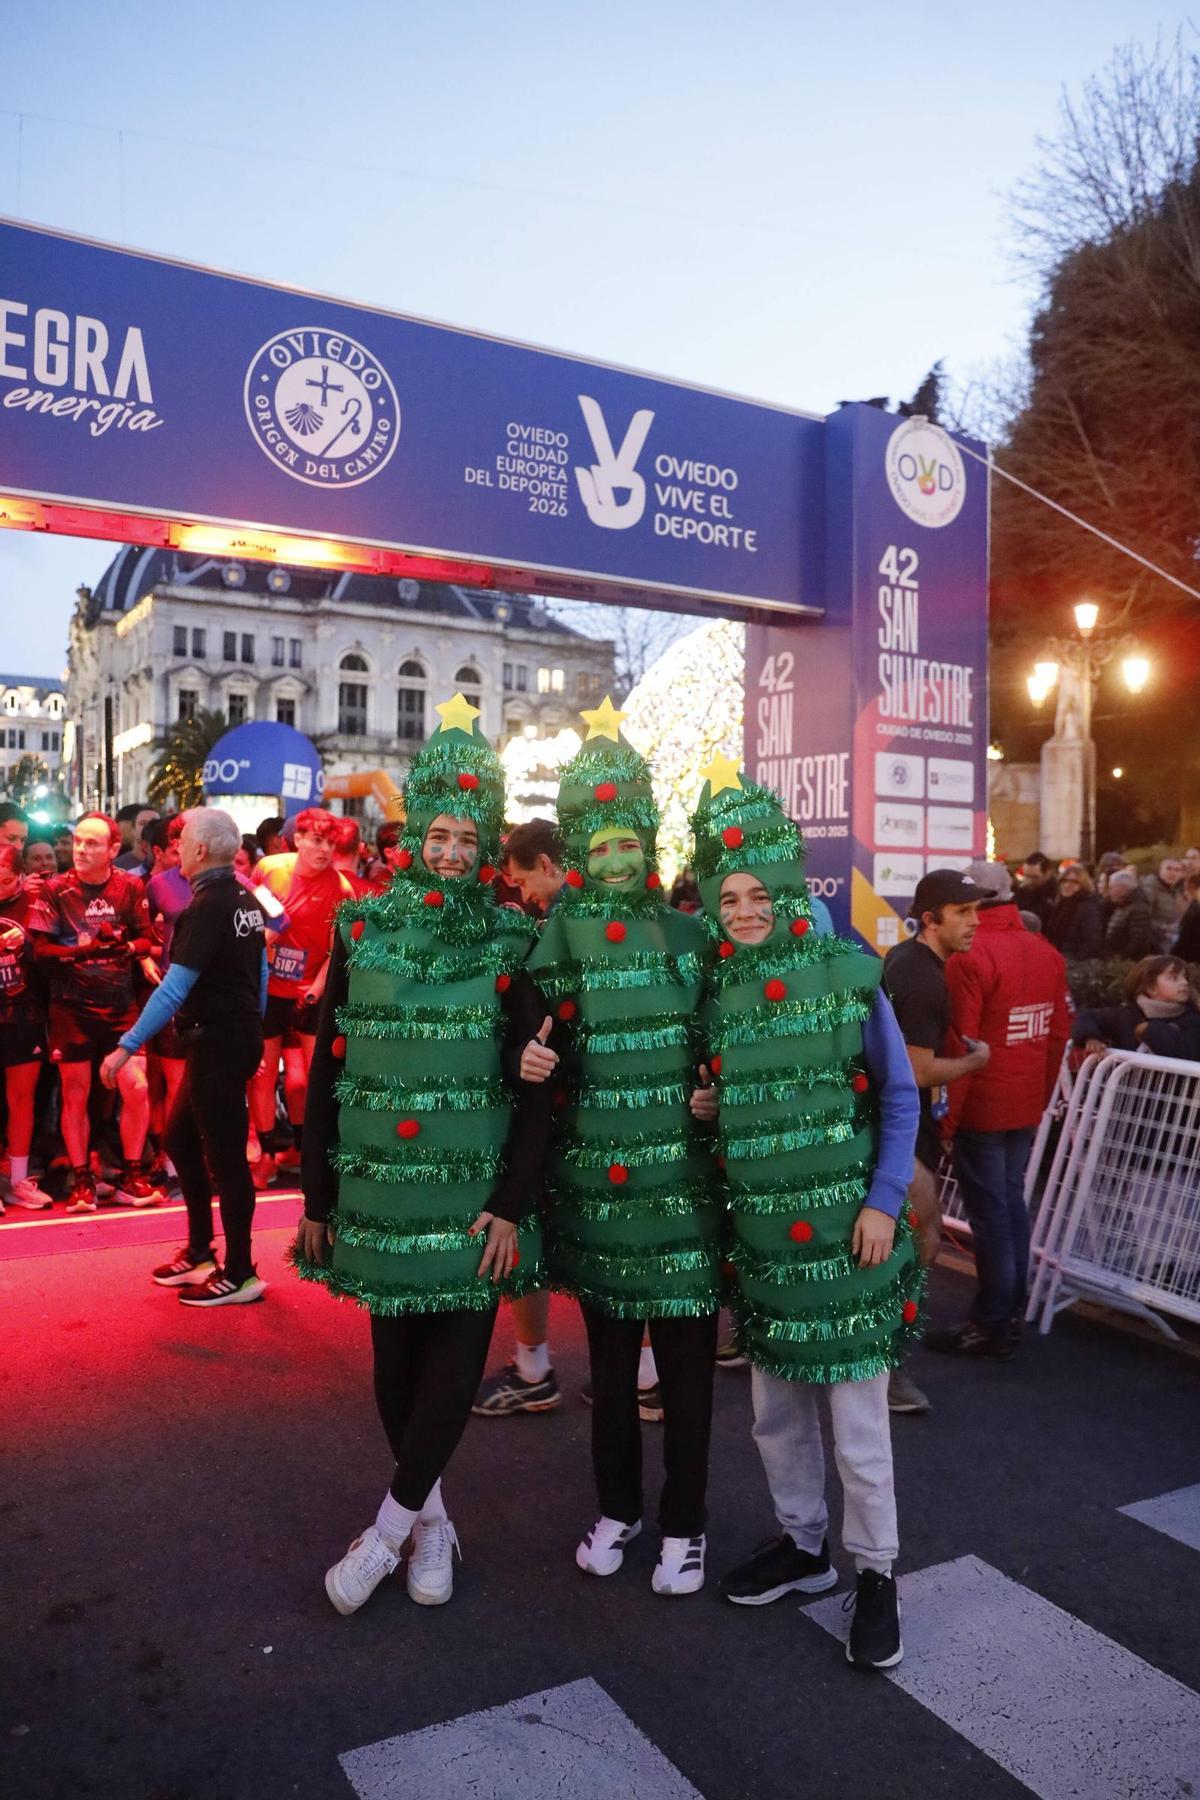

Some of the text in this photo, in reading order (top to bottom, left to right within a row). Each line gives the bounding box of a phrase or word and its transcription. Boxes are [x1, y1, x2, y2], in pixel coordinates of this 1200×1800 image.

[269, 333, 382, 390] OVIEDO
[255, 394, 391, 480] ORIGEN DEL CAMINO
[506, 422, 569, 448] OVIEDO
[506, 440, 569, 465] CIUDAD
[464, 467, 568, 501] DEL DEPORTE
[496, 455, 568, 482] EUROPEA
[655, 454, 739, 491] OVIEDO
[528, 496, 568, 518] 2026
[655, 483, 734, 520] VIVE EL
[655, 513, 758, 552] DEPORTE
[878, 544, 920, 589] 42
[878, 585, 919, 654] SAN
[758, 651, 795, 693] 42
[878, 652, 974, 728] SILVESTRE
[757, 692, 794, 758] SAN
[876, 723, 909, 737] CIUDAD
[909, 727, 922, 740] DE
[923, 728, 954, 743] OVIEDO
